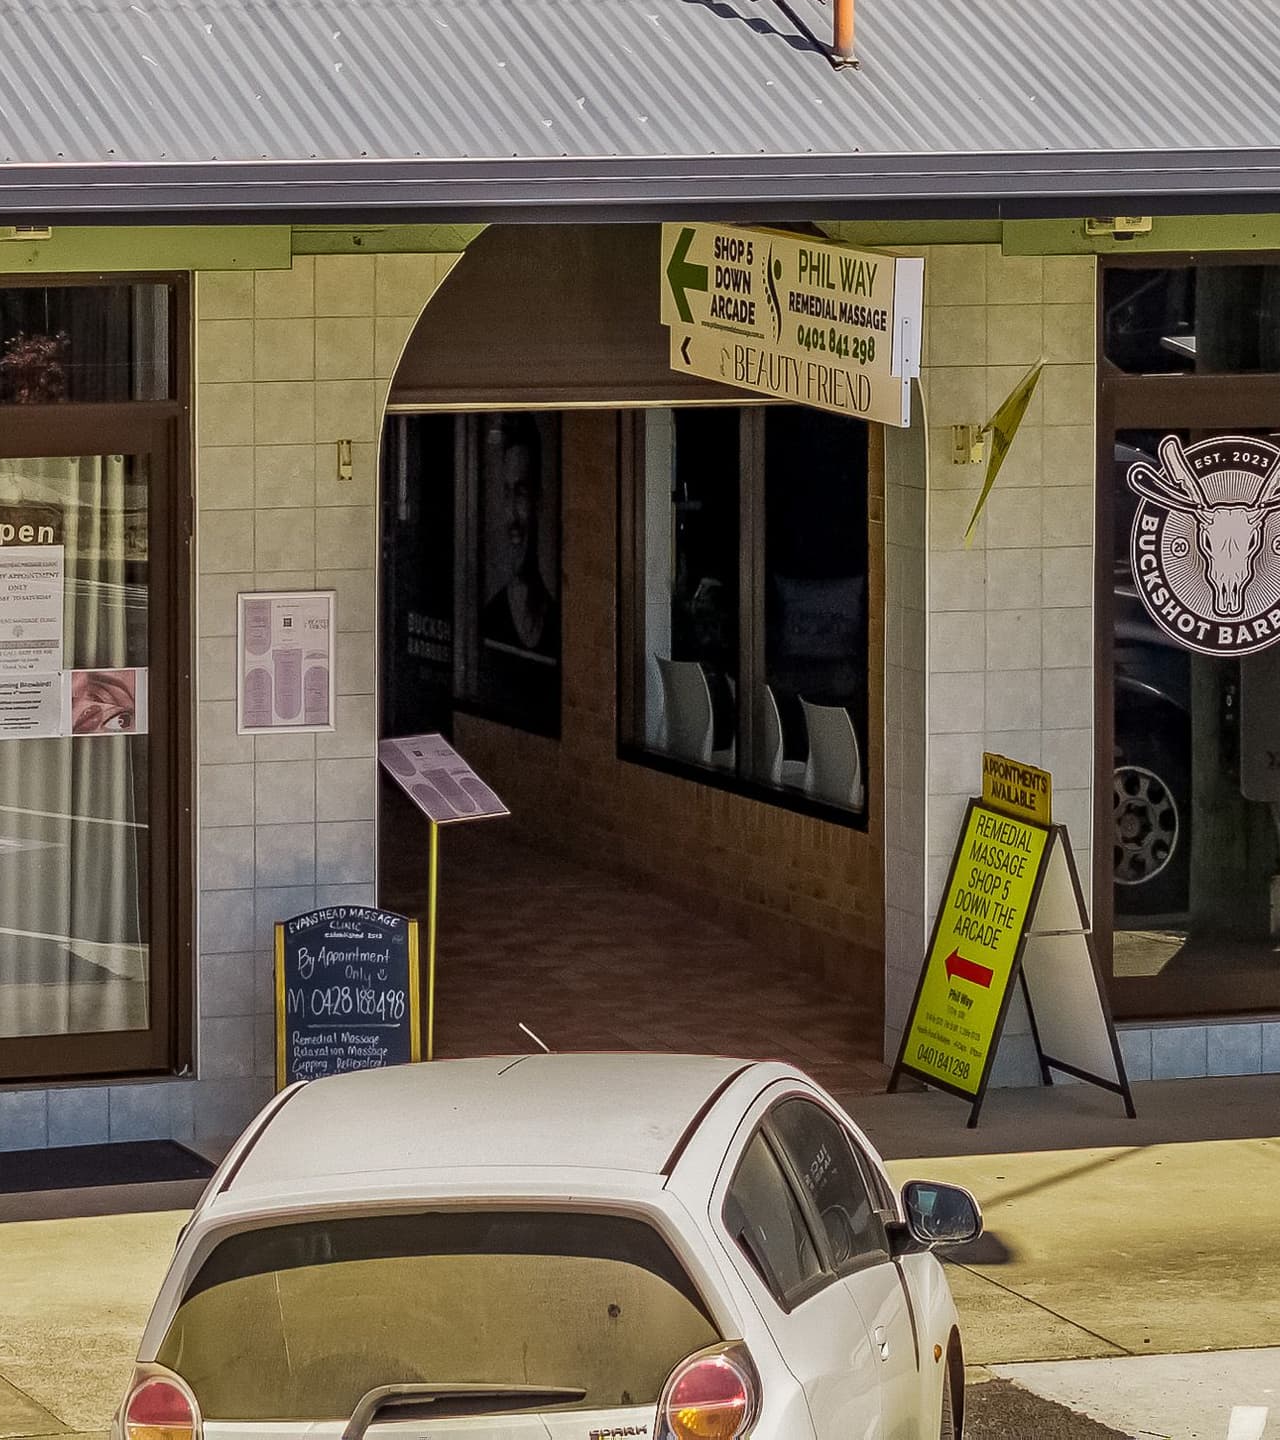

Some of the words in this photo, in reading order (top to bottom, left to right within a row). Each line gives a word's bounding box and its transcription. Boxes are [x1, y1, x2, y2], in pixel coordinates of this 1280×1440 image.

[714, 235, 745, 261] SHOP
[746, 241, 754, 266] 5
[715, 265, 752, 295] DOWN
[798, 248, 836, 290] PHIL
[839, 255, 878, 298] WAY
[710, 294, 756, 325] ARCADE
[788, 291, 838, 322] REMEDIAL
[839, 301, 888, 332] MASSAGE
[797, 324, 826, 351] 0401
[828, 327, 850, 359] 841
[852, 335, 875, 366] 298
[734, 344, 803, 396] BEAUTY
[807, 361, 871, 412] FRIEND
[1195, 453, 1226, 468] EST.
[1233, 452, 1269, 468] 2023
[1139, 514, 1210, 640] BUCKSHOT
[976, 814, 1033, 854] REMEDIAL
[970, 840, 1027, 879] MASSAGE
[968, 866, 1000, 896] SHOP
[1001, 879, 1010, 900] 5
[349, 908, 400, 927] MASSAGE
[954, 889, 990, 920] DOWN
[993, 902, 1017, 929] THE
[329, 920, 361, 931] CLINIC
[953, 915, 1002, 950] ARCADE
[298, 947, 315, 980] By
[318, 946, 390, 968] Appointment
[345, 965, 370, 982] Only
[288, 988, 305, 1018] M
[948, 988, 961, 1002] Phil
[960, 994, 974, 1010] Way
[293, 1031, 337, 1044] Remedial
[341, 1032, 379, 1046] Massage
[294, 1046, 344, 1057] Relaxation
[348, 1046, 388, 1061] Massage
